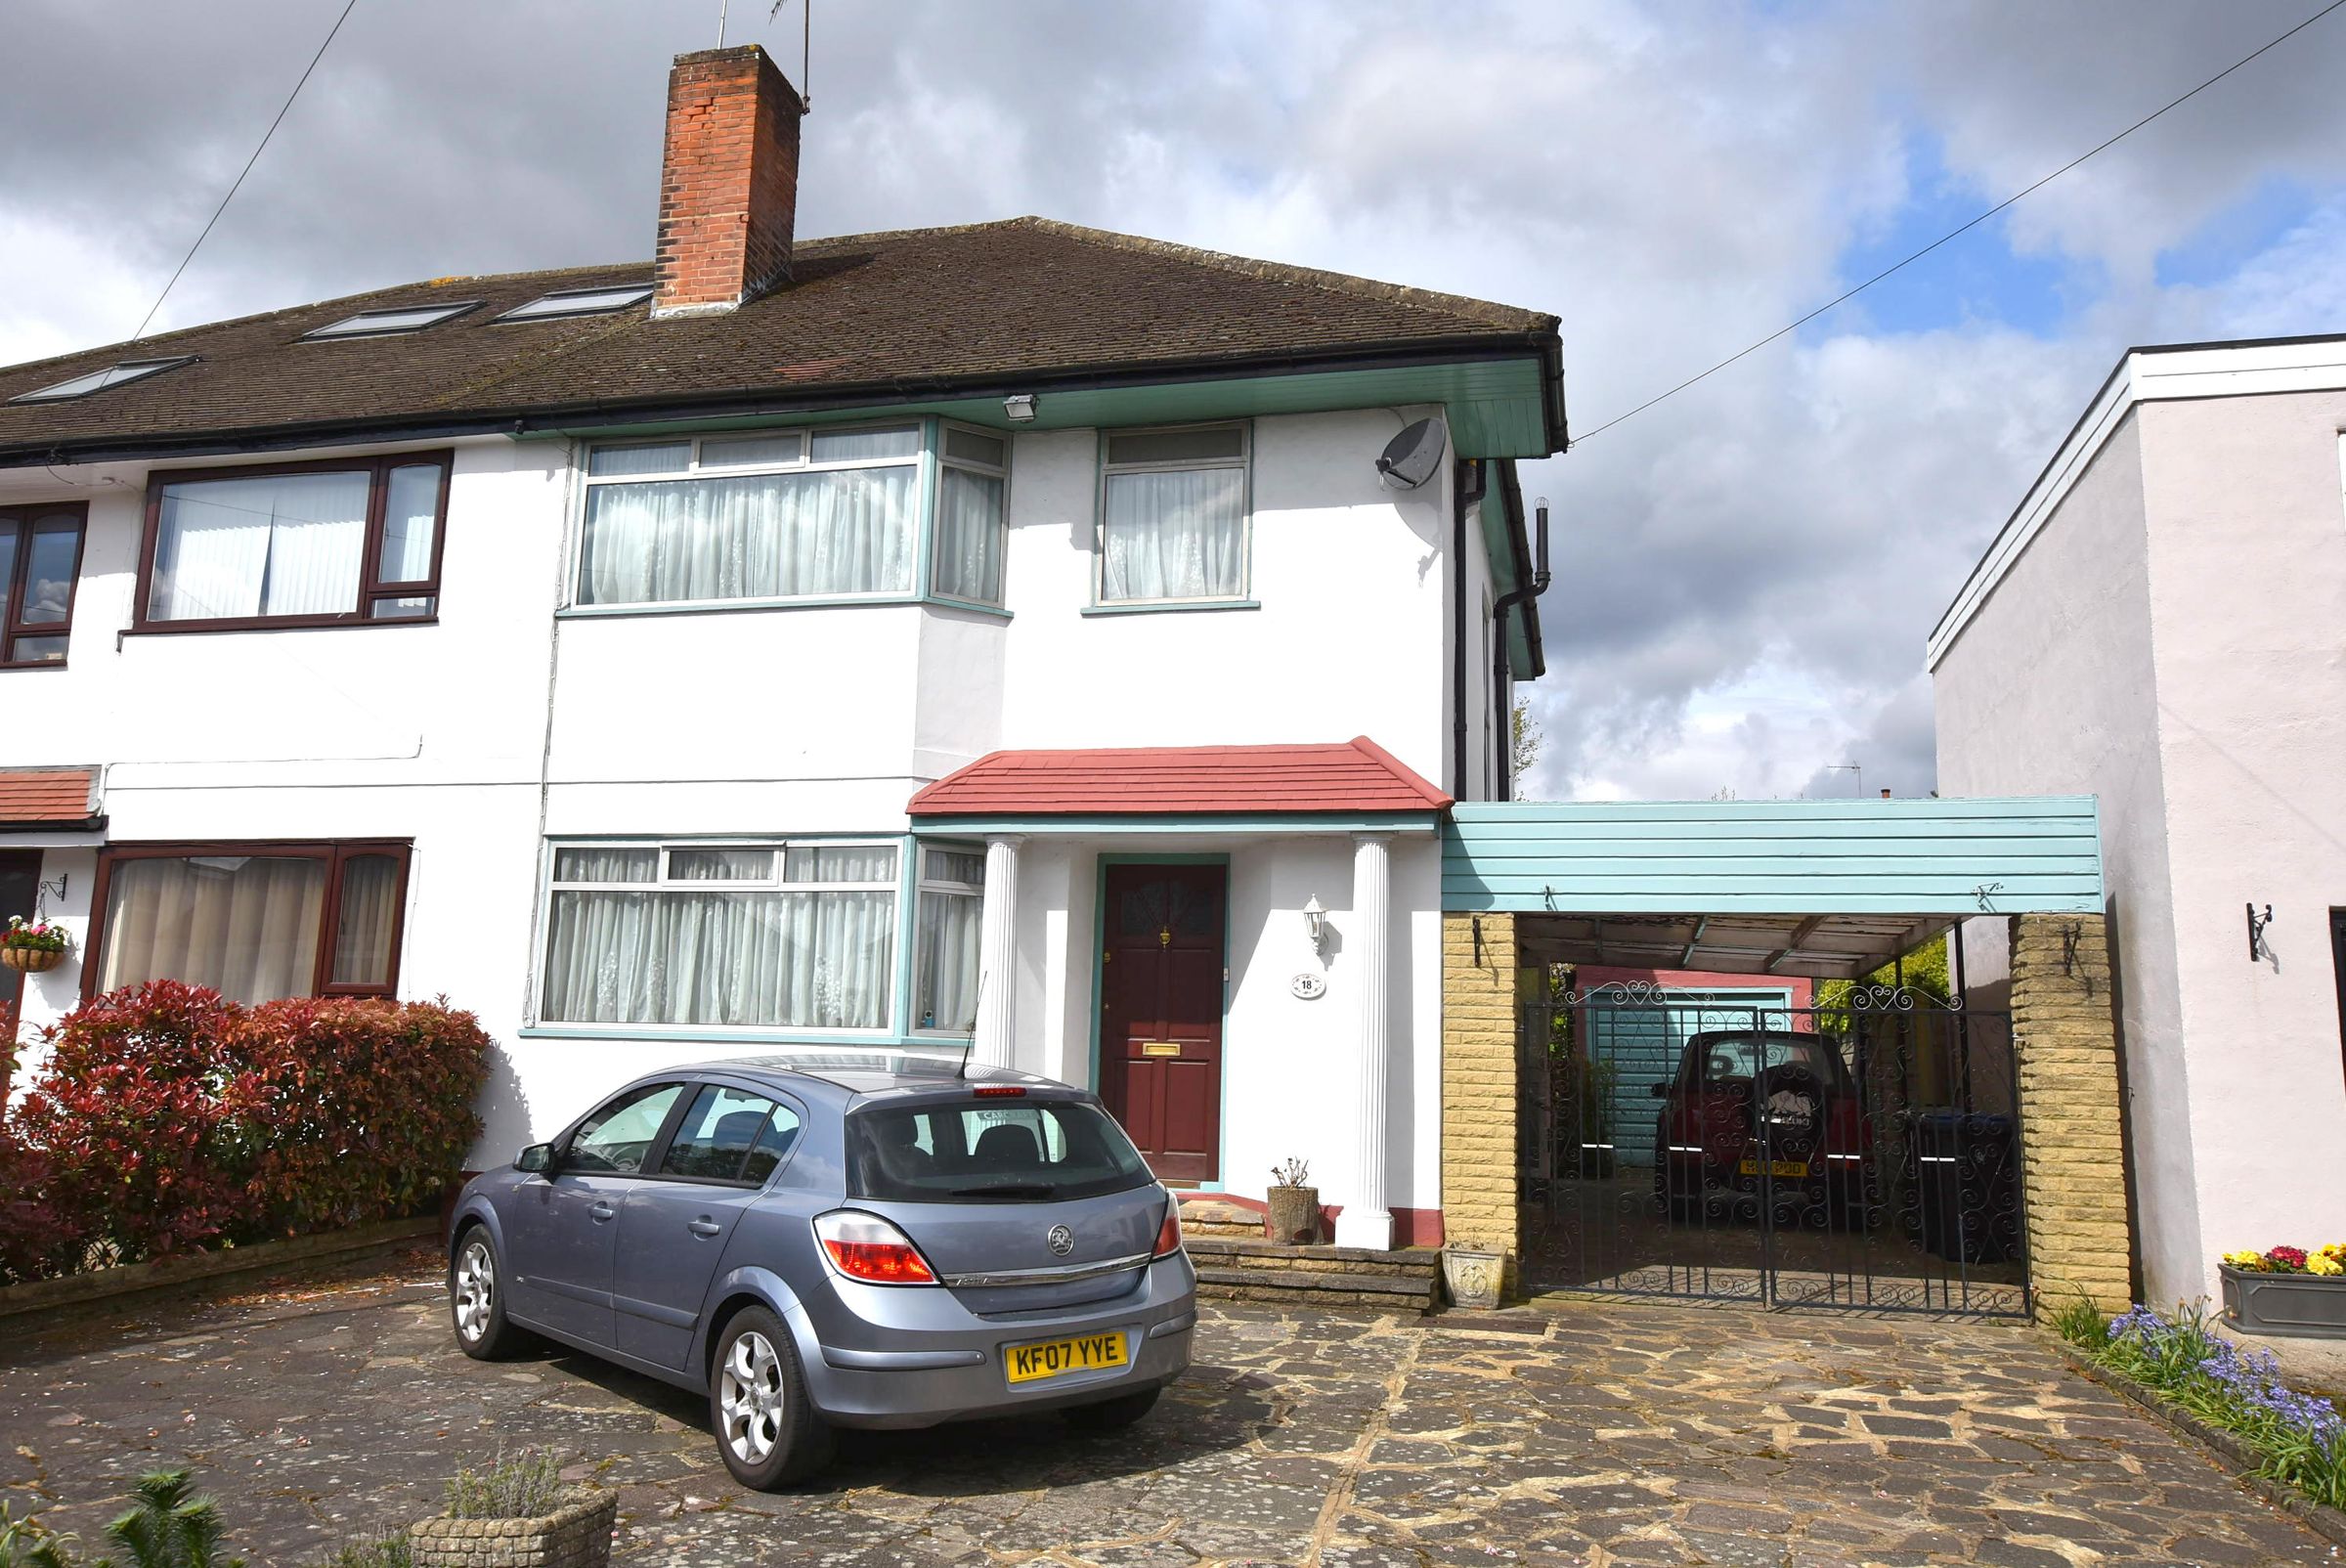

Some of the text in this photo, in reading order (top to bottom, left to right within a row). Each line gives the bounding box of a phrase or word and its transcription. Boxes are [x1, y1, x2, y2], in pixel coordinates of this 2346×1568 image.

[1302, 980, 1312, 989] 18
[1017, 1336, 1118, 1374] KF07 YYE
